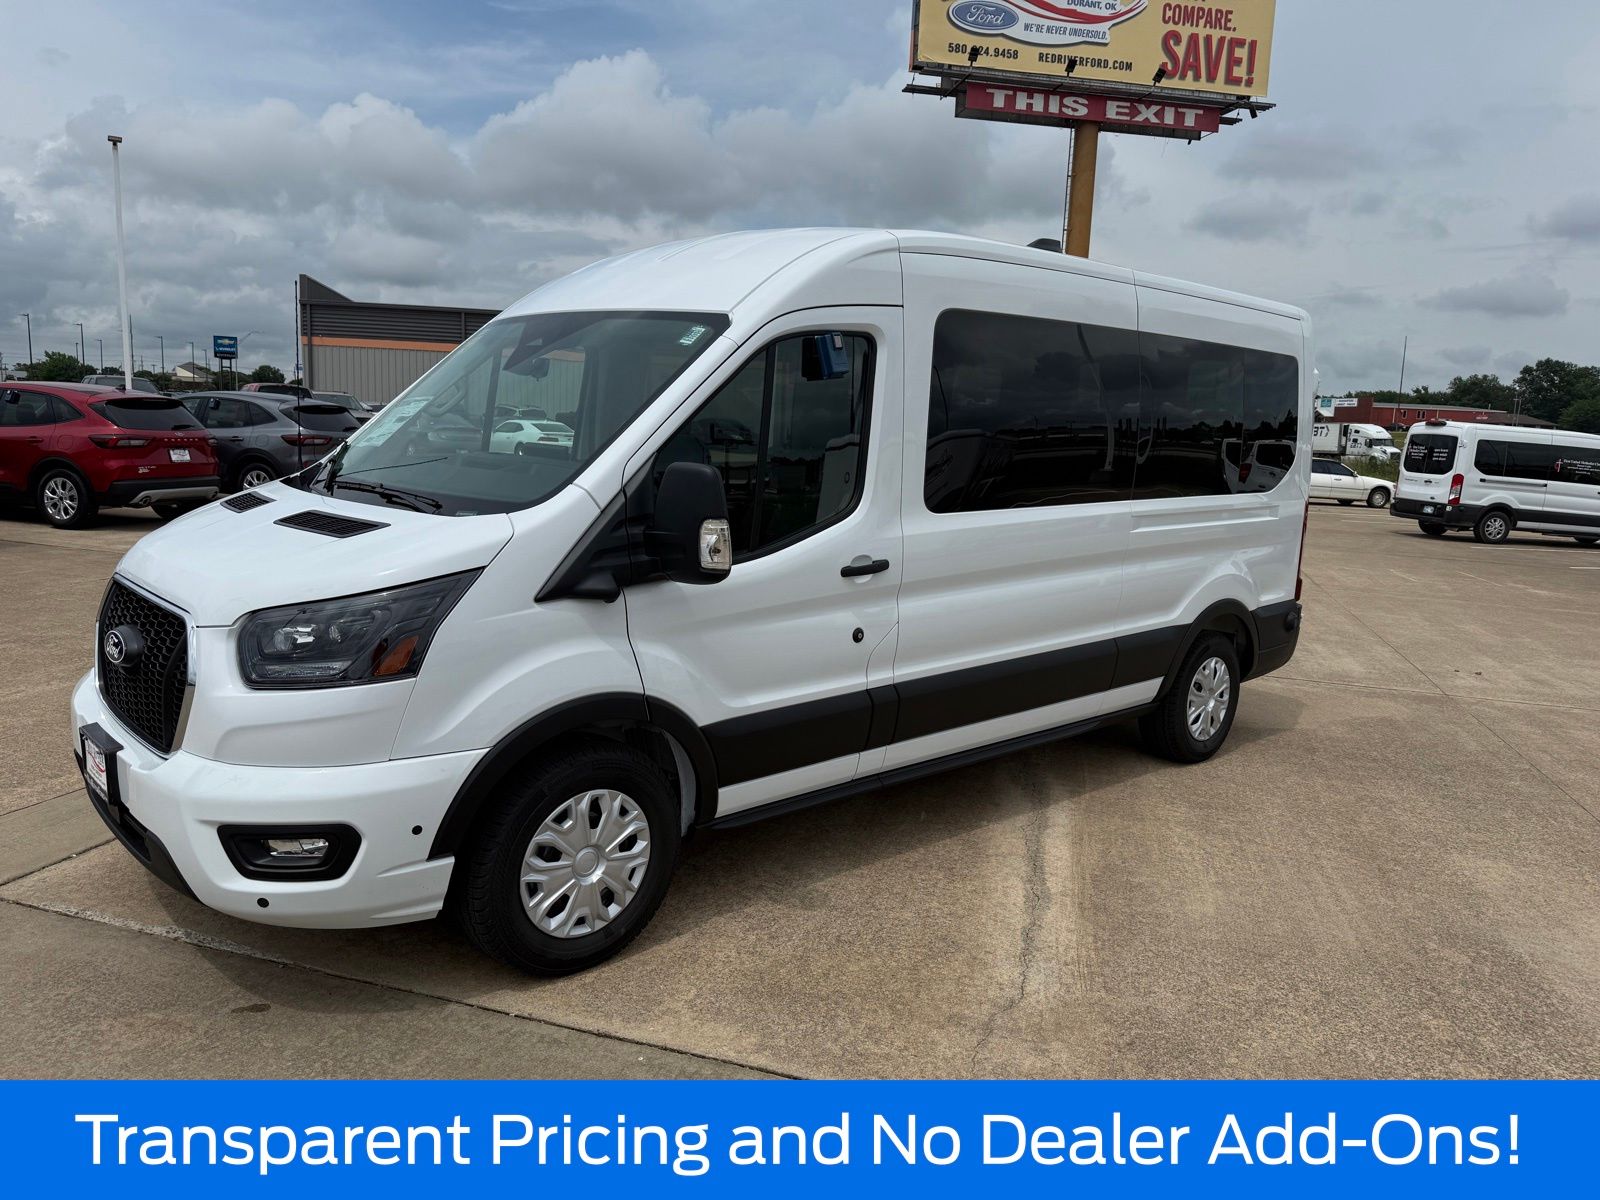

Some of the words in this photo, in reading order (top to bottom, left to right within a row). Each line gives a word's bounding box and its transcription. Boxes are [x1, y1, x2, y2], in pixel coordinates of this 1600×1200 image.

[967, 4, 1005, 24] Ford
[1104, 2, 1118, 11] OK
[1162, 2, 1237, 32] COMPARE.
[1023, 22, 1044, 34] WE'RE
[1045, 25, 1067, 36] NEVER
[1068, 27, 1108, 40] UNDERSOLD.
[948, 42, 1019, 60] 580.24.9458
[1161, 29, 1258, 88] SAVE!
[986, 88, 1089, 117] THIS
[1105, 101, 1204, 127] EXIT
[106, 634, 120, 659] Ford
